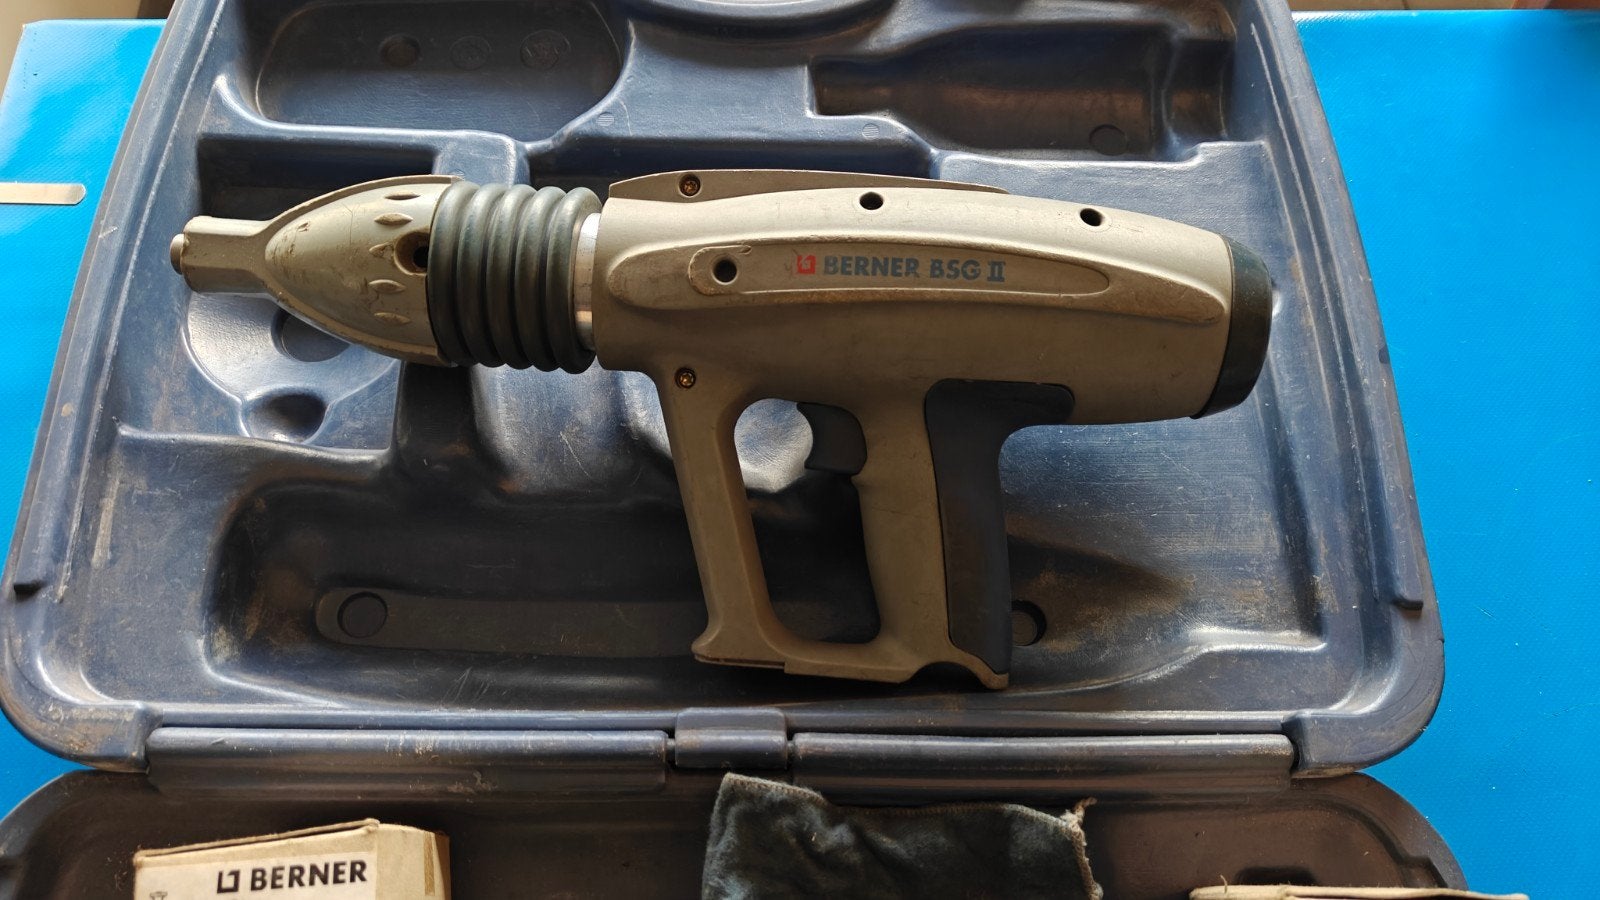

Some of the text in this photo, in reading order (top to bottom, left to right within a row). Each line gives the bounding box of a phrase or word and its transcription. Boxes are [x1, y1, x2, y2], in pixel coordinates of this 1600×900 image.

[823, 256, 1006, 283] BERNER BSG II
[249, 860, 368, 892] BERNER
